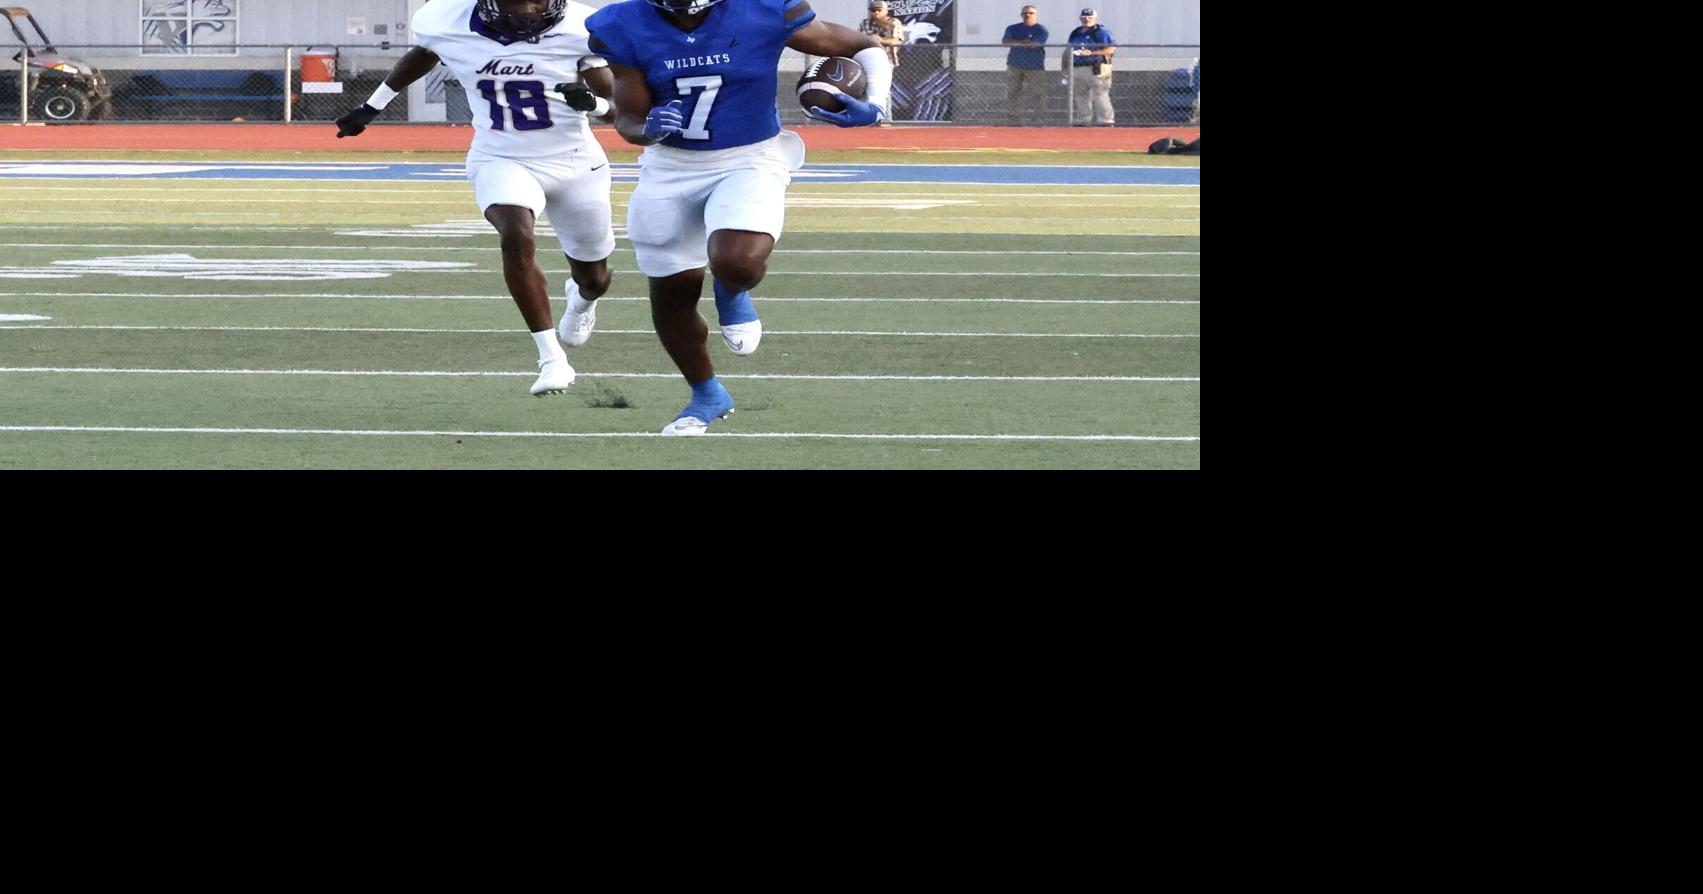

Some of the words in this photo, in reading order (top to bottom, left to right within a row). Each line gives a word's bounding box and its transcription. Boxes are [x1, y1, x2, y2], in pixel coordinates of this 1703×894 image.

[475, 59, 534, 76] Mart
[664, 53, 730, 70] WILDCATS
[477, 79, 554, 131] 18
[675, 74, 723, 140] 7
